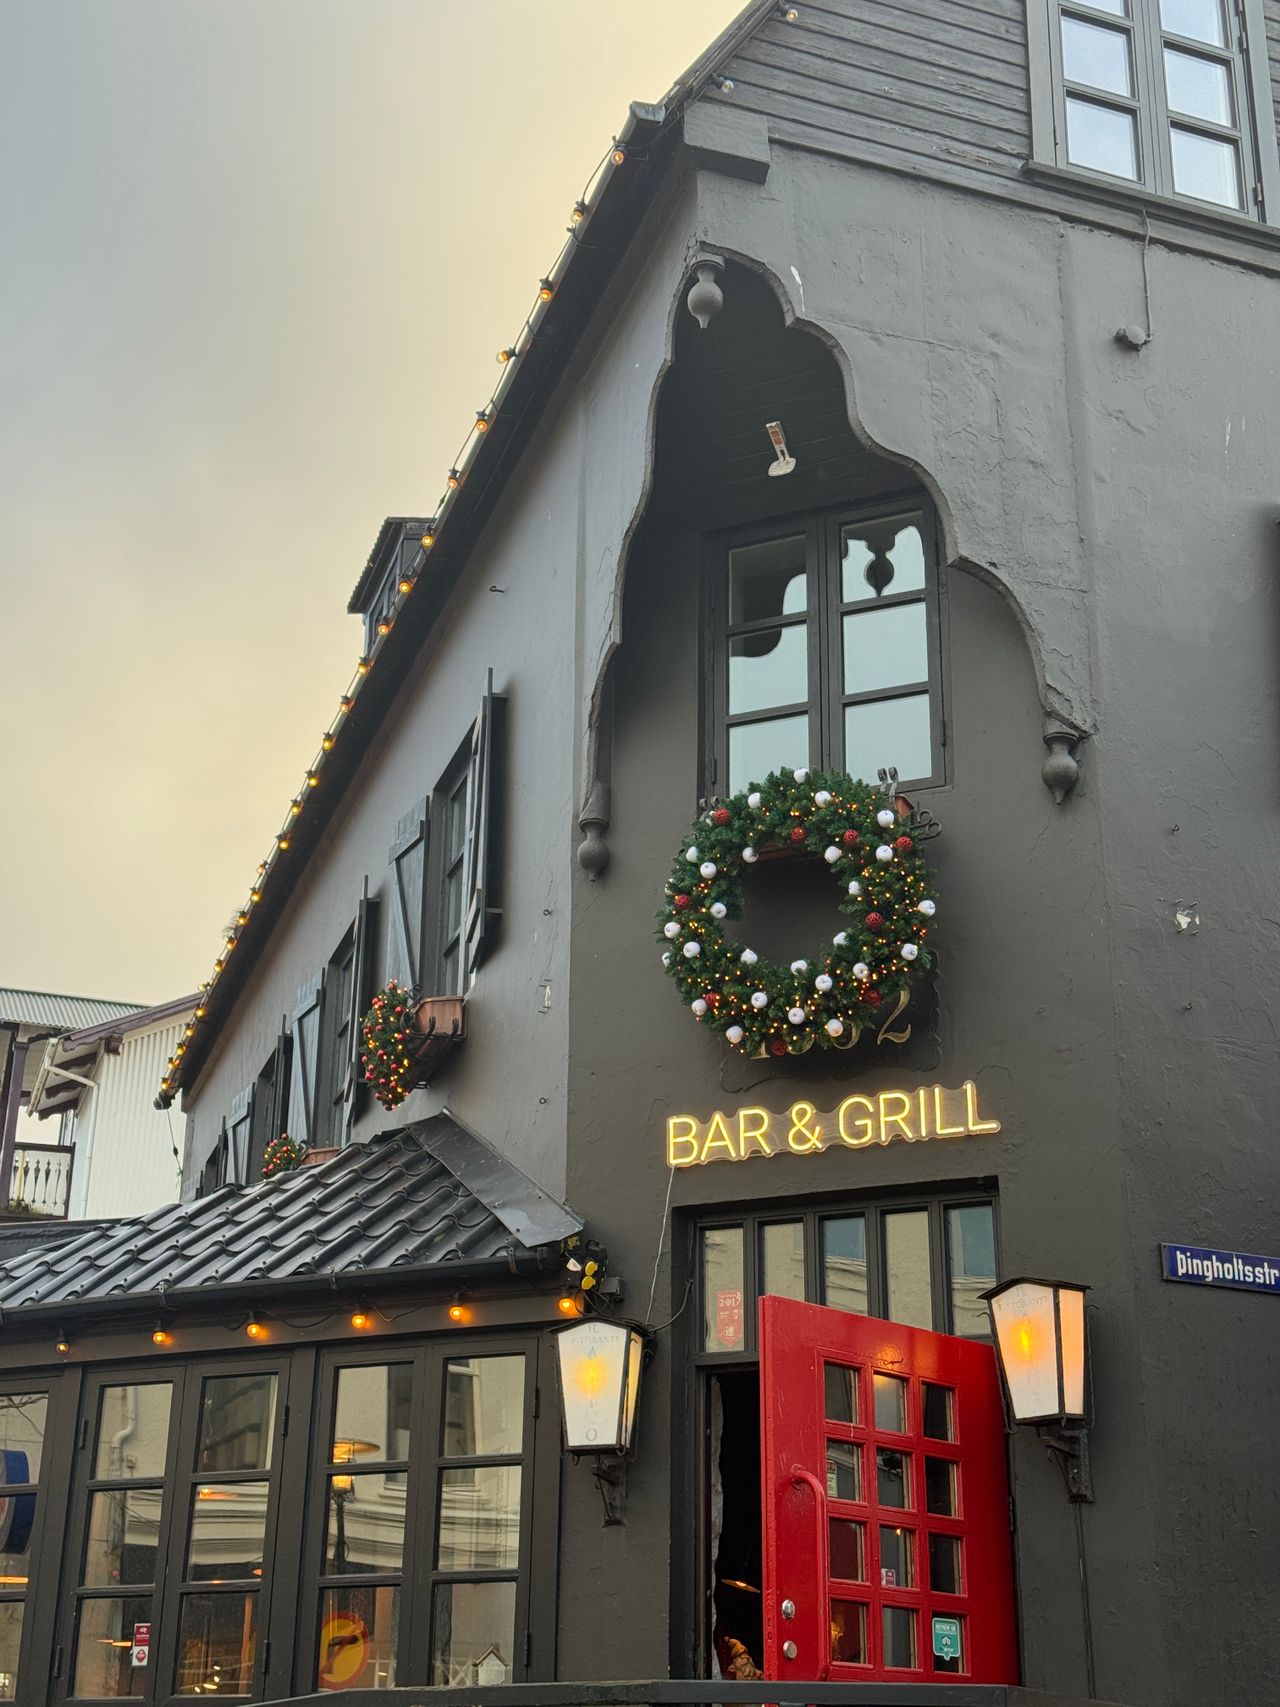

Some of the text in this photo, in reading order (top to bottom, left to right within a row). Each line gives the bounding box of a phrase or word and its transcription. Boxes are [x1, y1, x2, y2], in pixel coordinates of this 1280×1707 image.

[667, 1082, 998, 1166] BAR & GRILL
